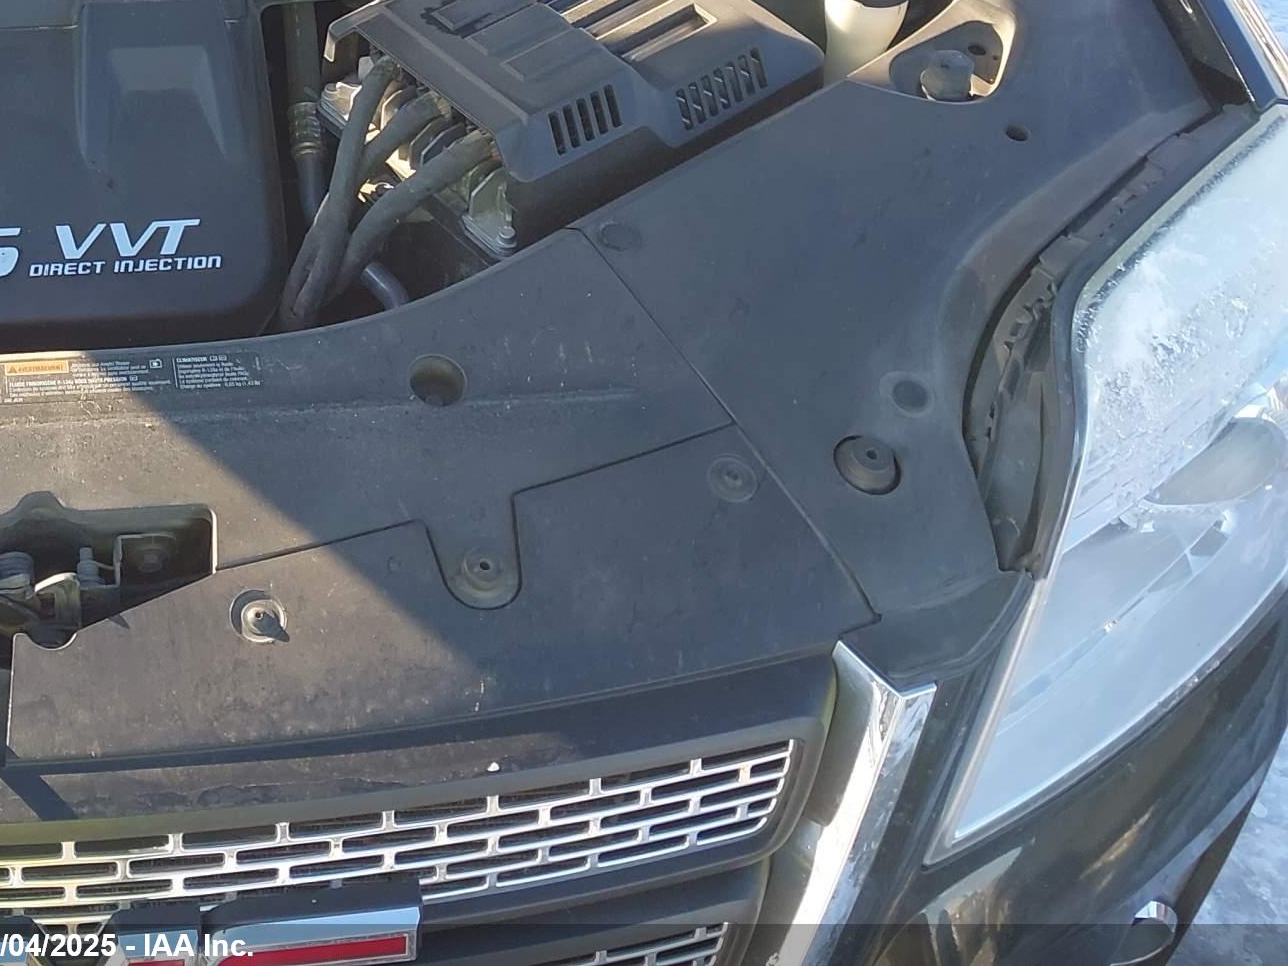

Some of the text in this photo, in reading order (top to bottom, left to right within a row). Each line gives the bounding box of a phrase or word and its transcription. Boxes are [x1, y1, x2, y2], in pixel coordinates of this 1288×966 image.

[55, 218, 201, 260] VVT
[29, 256, 222, 277] DIRECT INJECTION
